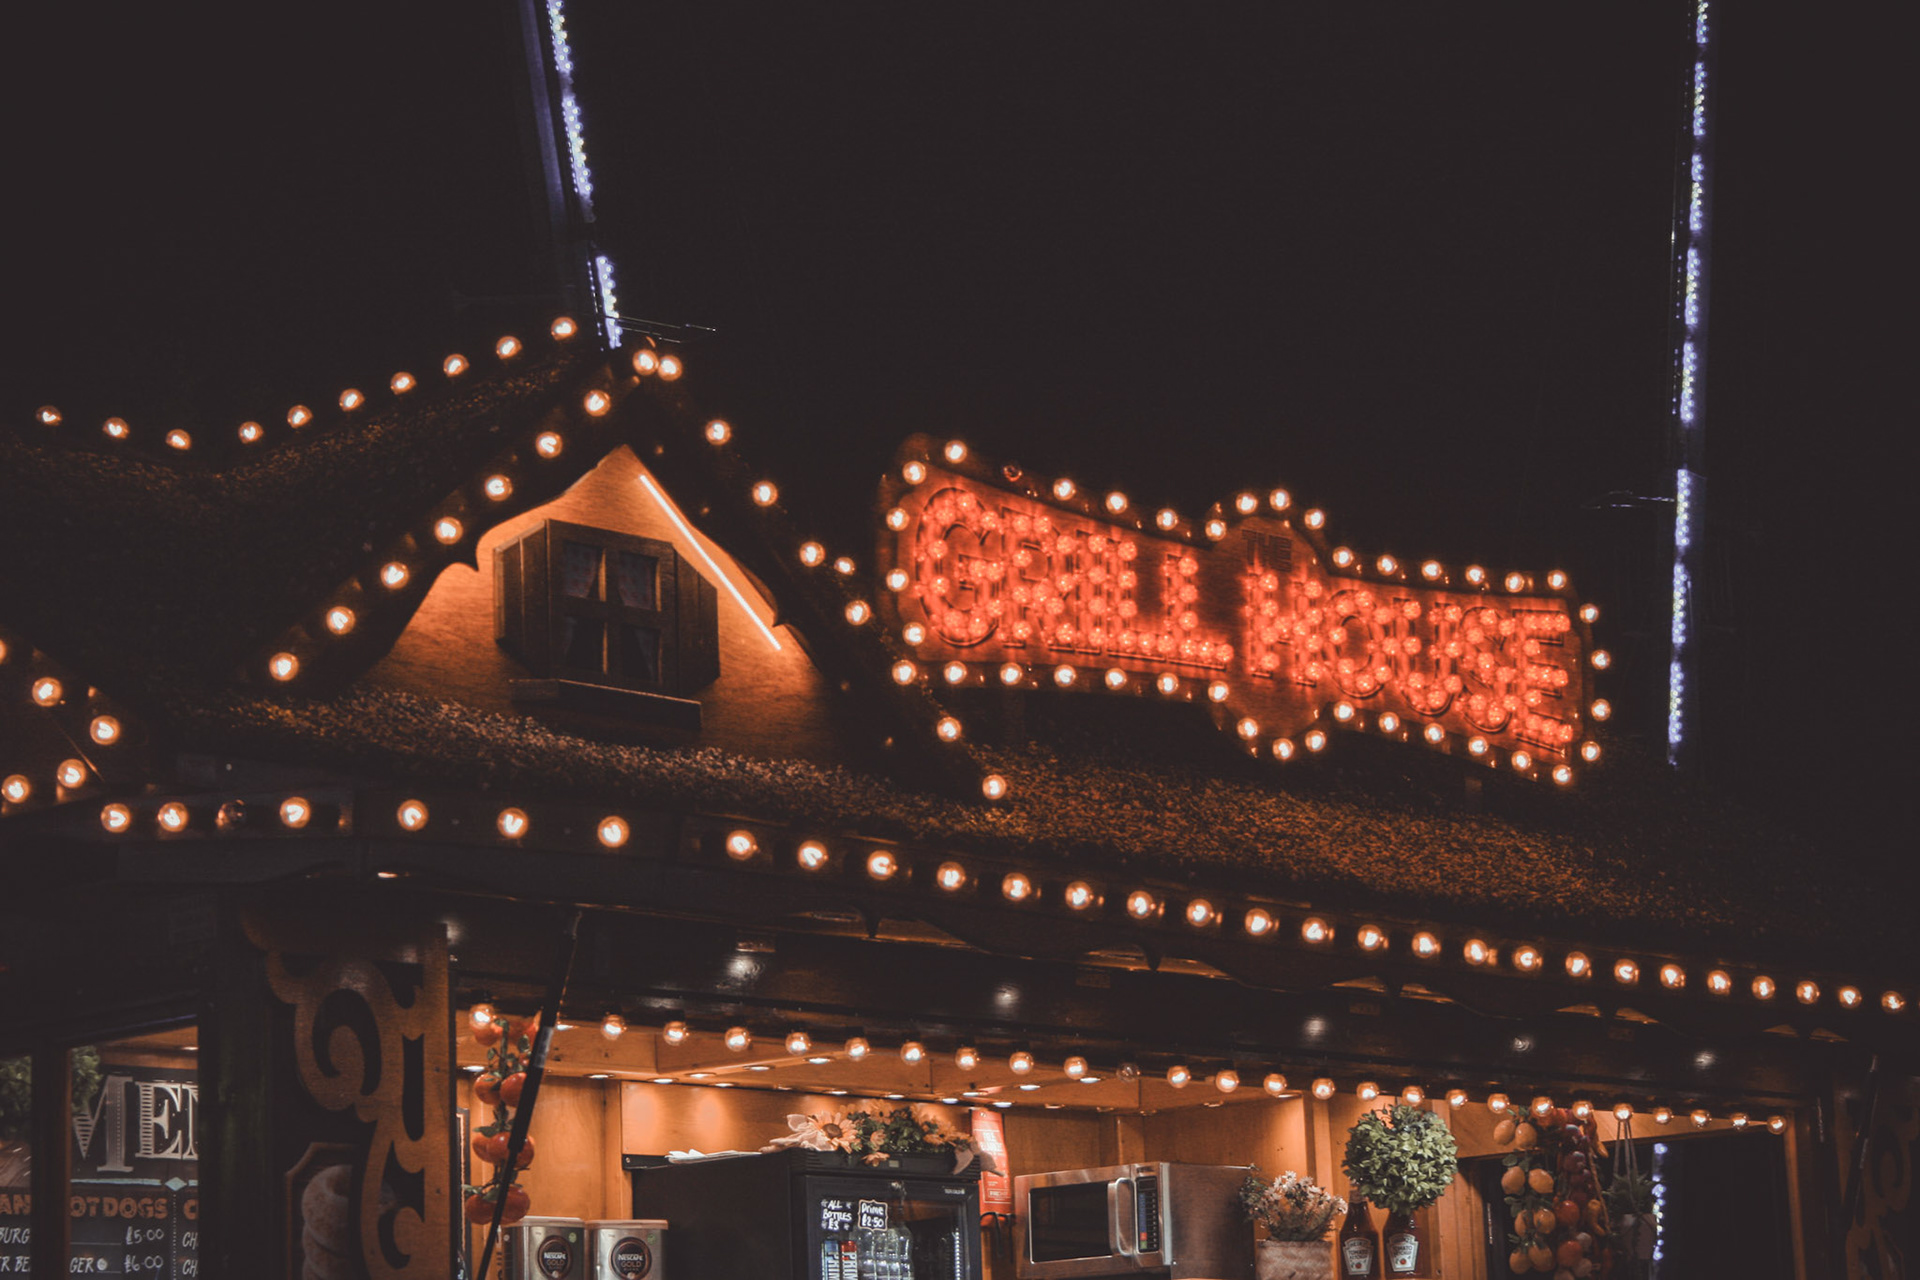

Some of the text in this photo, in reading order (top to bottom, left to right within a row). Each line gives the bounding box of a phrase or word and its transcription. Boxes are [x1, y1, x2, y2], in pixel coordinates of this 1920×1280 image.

[1241, 529, 1292, 572] THE
[914, 486, 1574, 756] GRILL HOUSE
[827, 1200, 843, 1210] ALL
[822, 1208, 852, 1221] BOTTLES
[14, 1256, 31, 1272] BE
